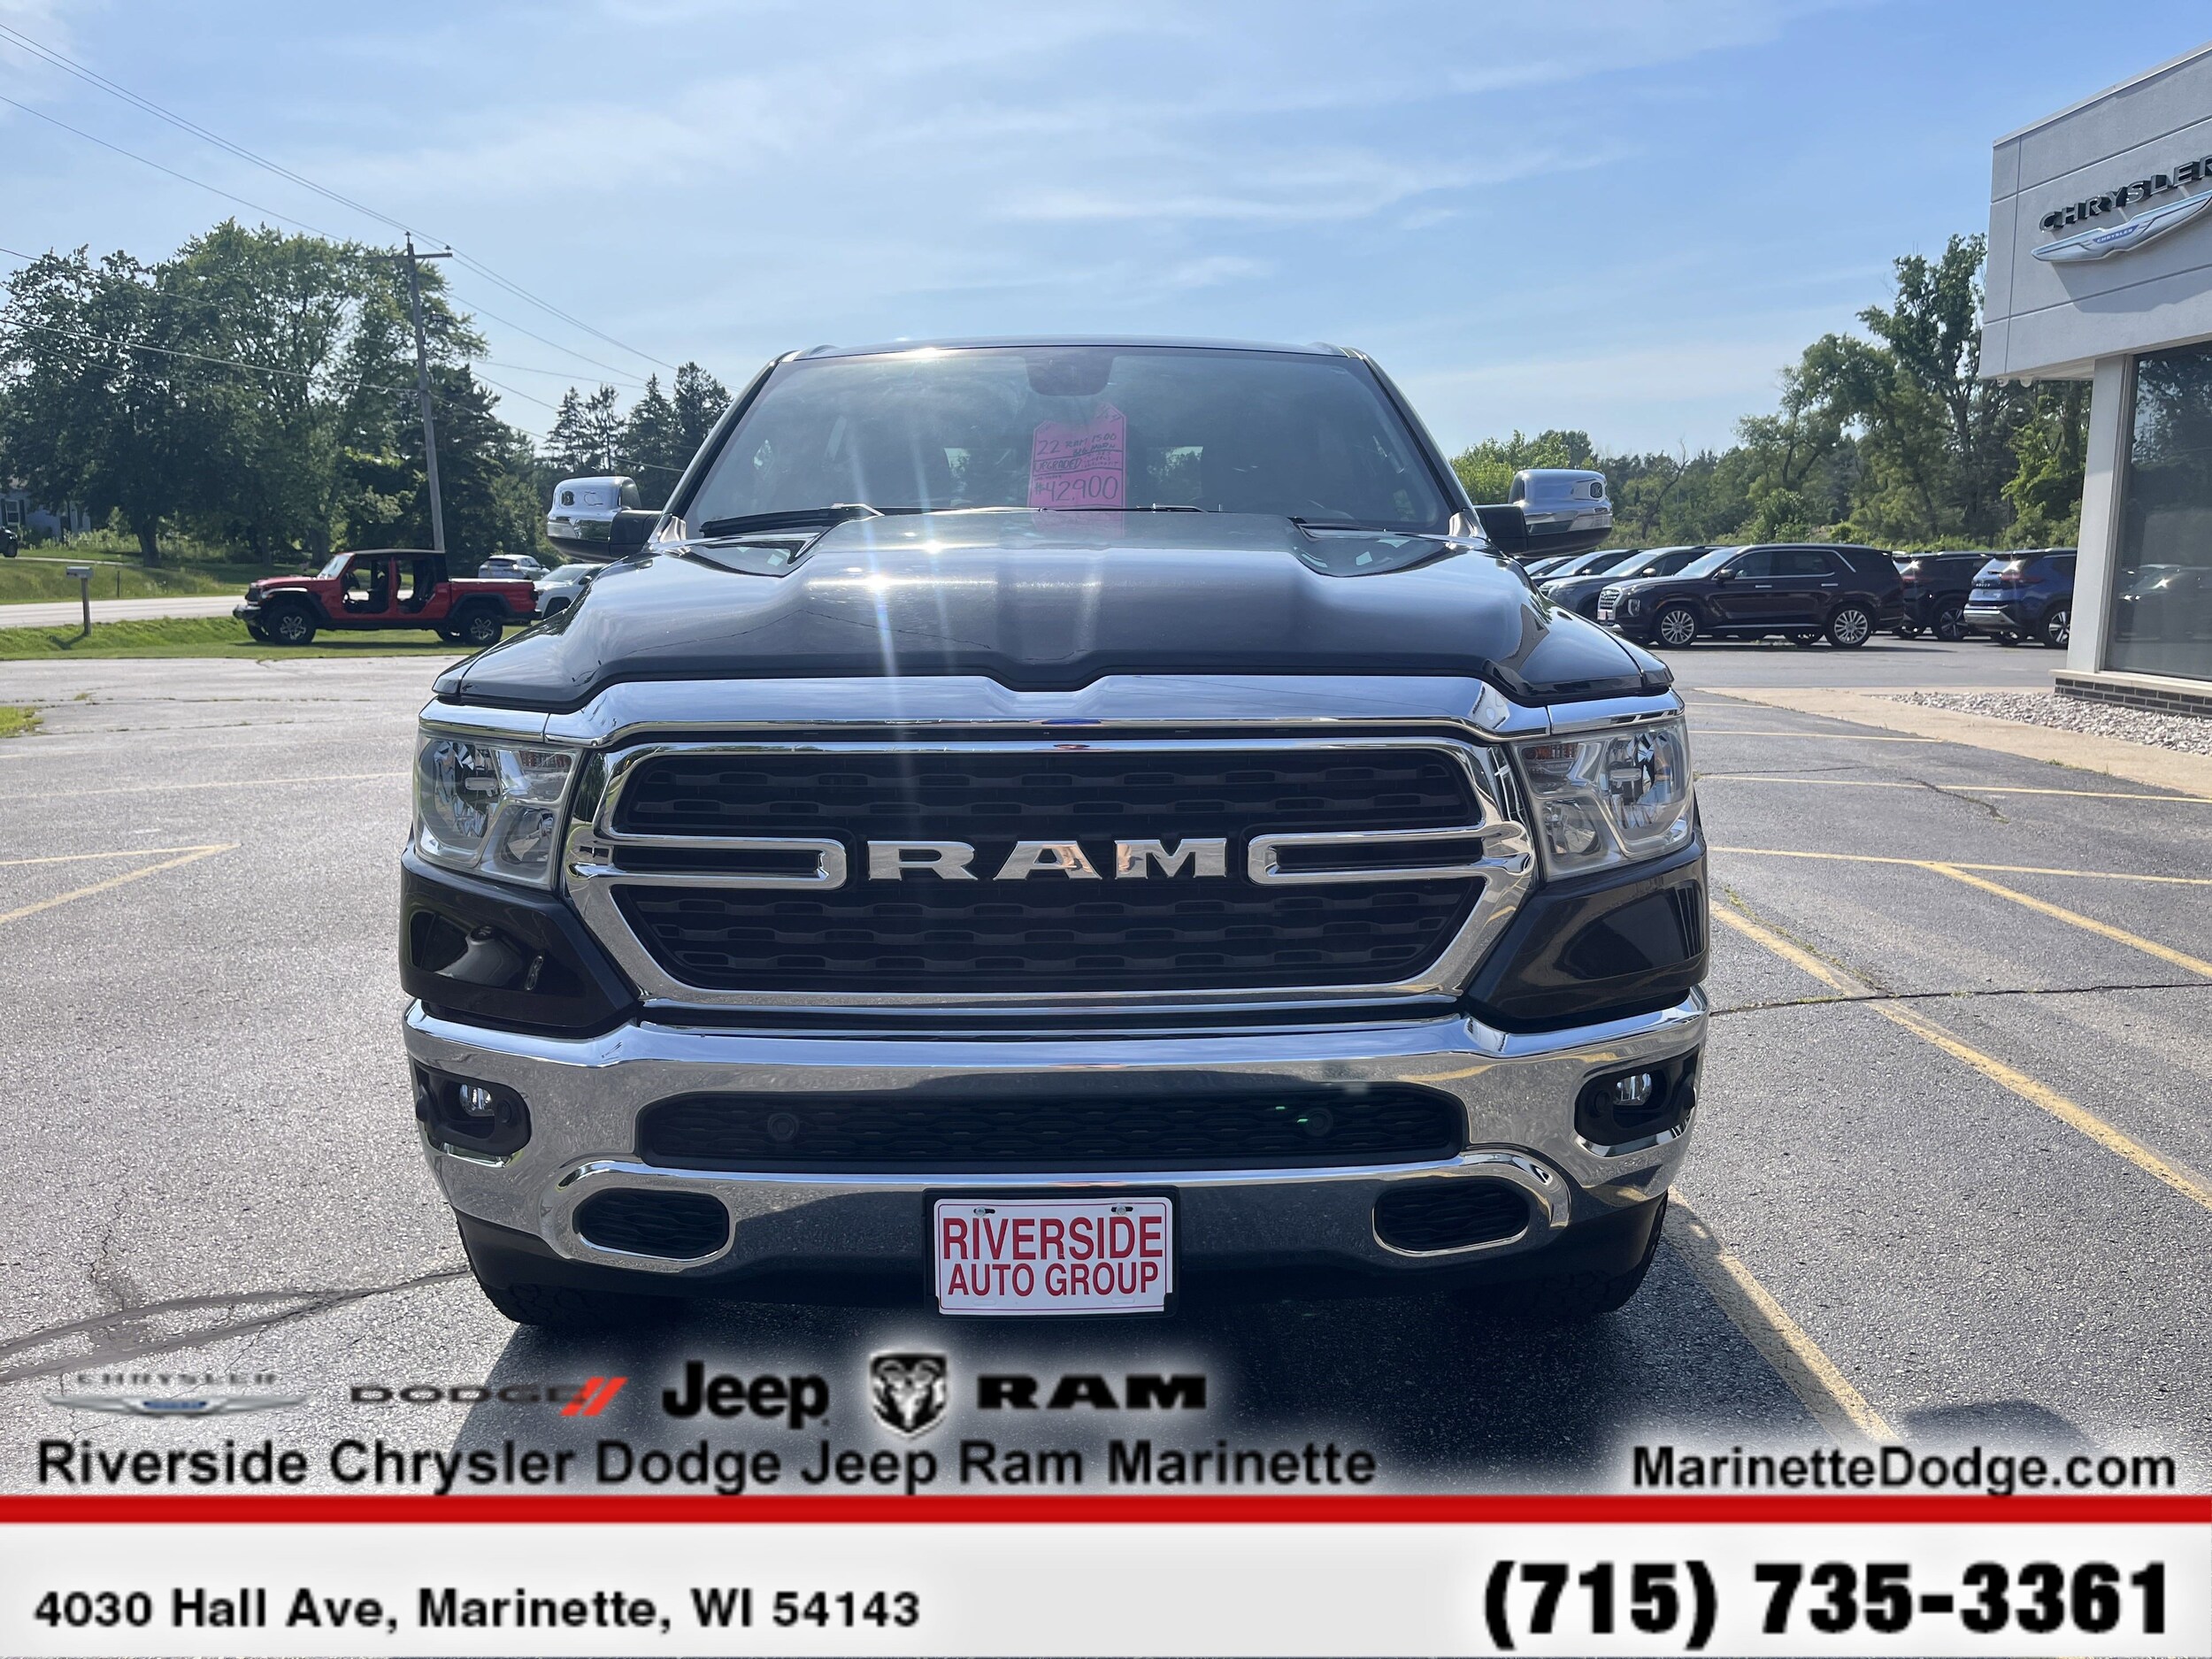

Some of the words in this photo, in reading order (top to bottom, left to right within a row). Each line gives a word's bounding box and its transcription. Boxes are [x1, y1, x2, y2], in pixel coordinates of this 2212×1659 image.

[1036, 440, 1062, 456] 22
[1091, 433, 1117, 443] 1500
[867, 837, 1227, 881] RAM
[942, 1216, 1164, 1261] RIVERSIDE
[947, 1263, 1035, 1297] AUTO
[1044, 1261, 1159, 1297] GROUP
